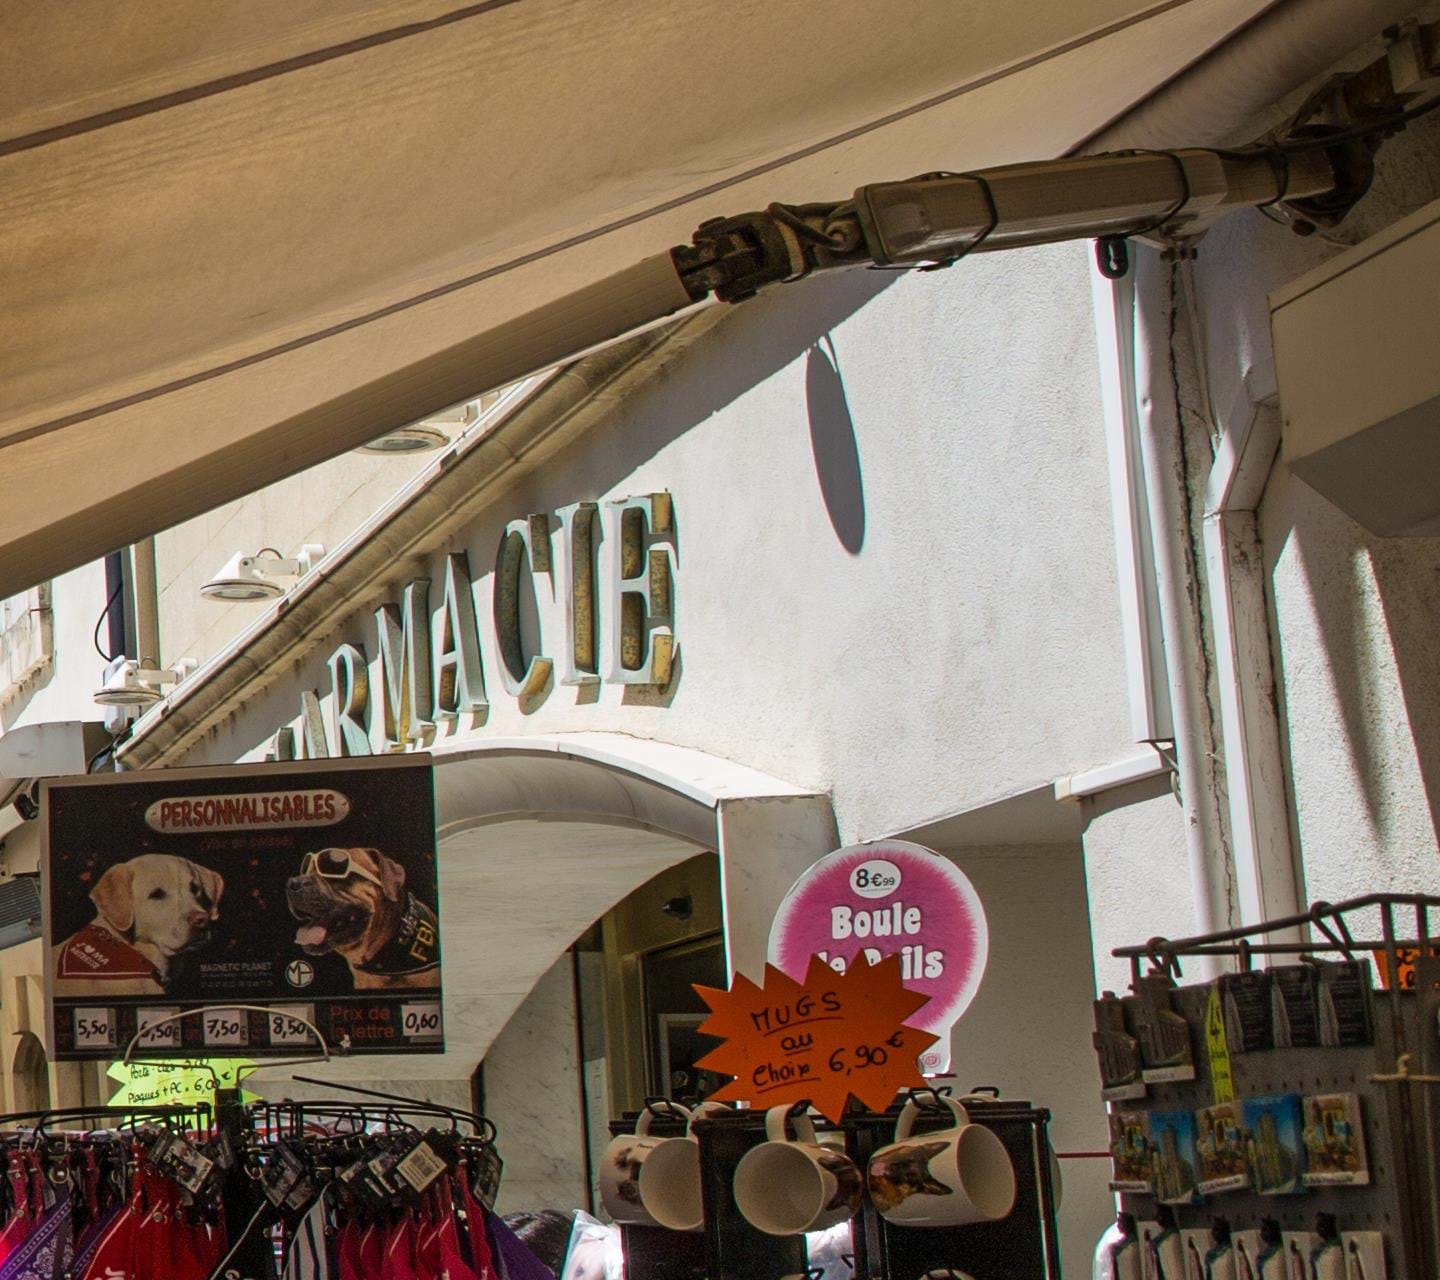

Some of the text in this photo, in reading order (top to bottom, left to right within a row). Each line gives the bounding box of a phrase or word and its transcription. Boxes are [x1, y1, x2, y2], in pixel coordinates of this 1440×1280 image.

[159, 794, 336, 829] PERSONNALISABLES
[831, 901, 923, 942] Boule
[863, 944, 945, 981] Pils
[329, 1005, 392, 1021] Prix de
[750, 991, 844, 1033] MUGS
[780, 1034, 815, 1053] au
